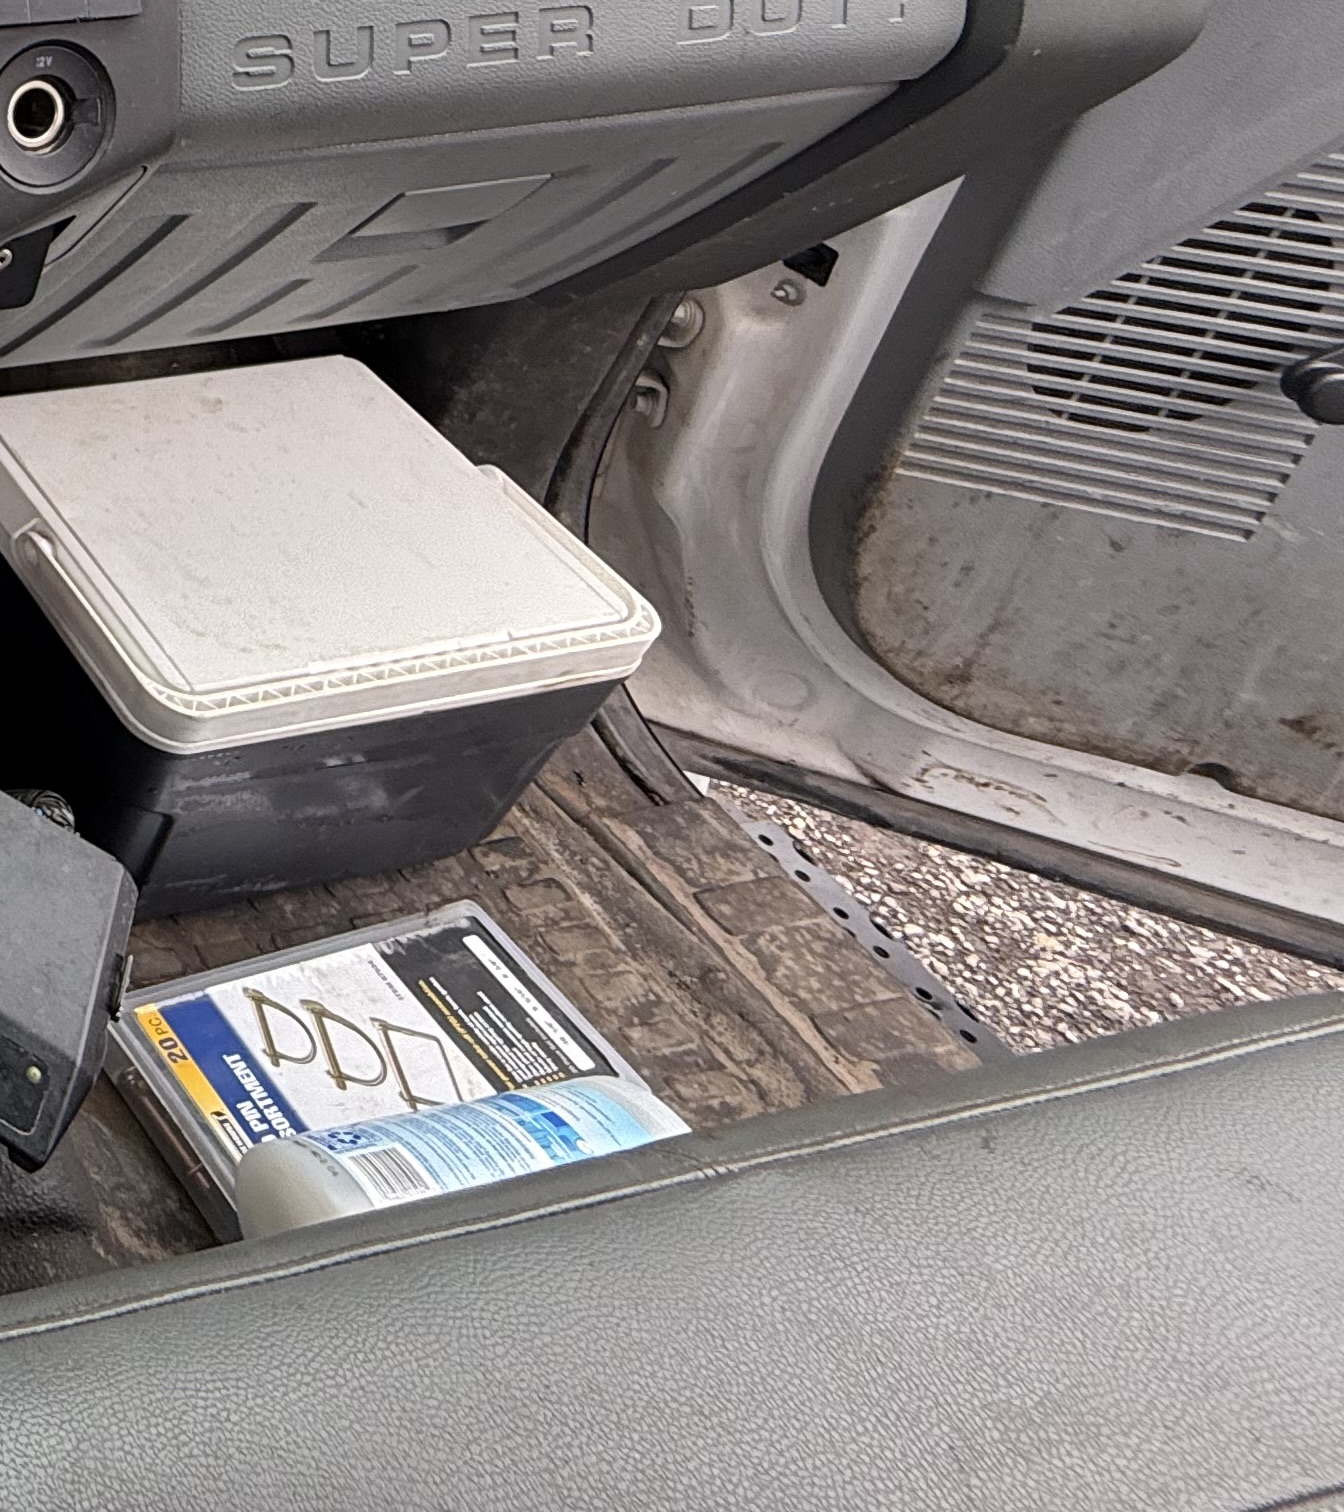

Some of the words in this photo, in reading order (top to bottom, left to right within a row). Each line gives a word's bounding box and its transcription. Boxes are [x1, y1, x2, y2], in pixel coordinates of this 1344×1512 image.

[230, 3, 595, 90] SUPER
[148, 1017, 169, 1036] PC
[158, 1037, 188, 1064] 20
[222, 1053, 297, 1138] SORTMENT
[236, 1100, 269, 1133] PIN
